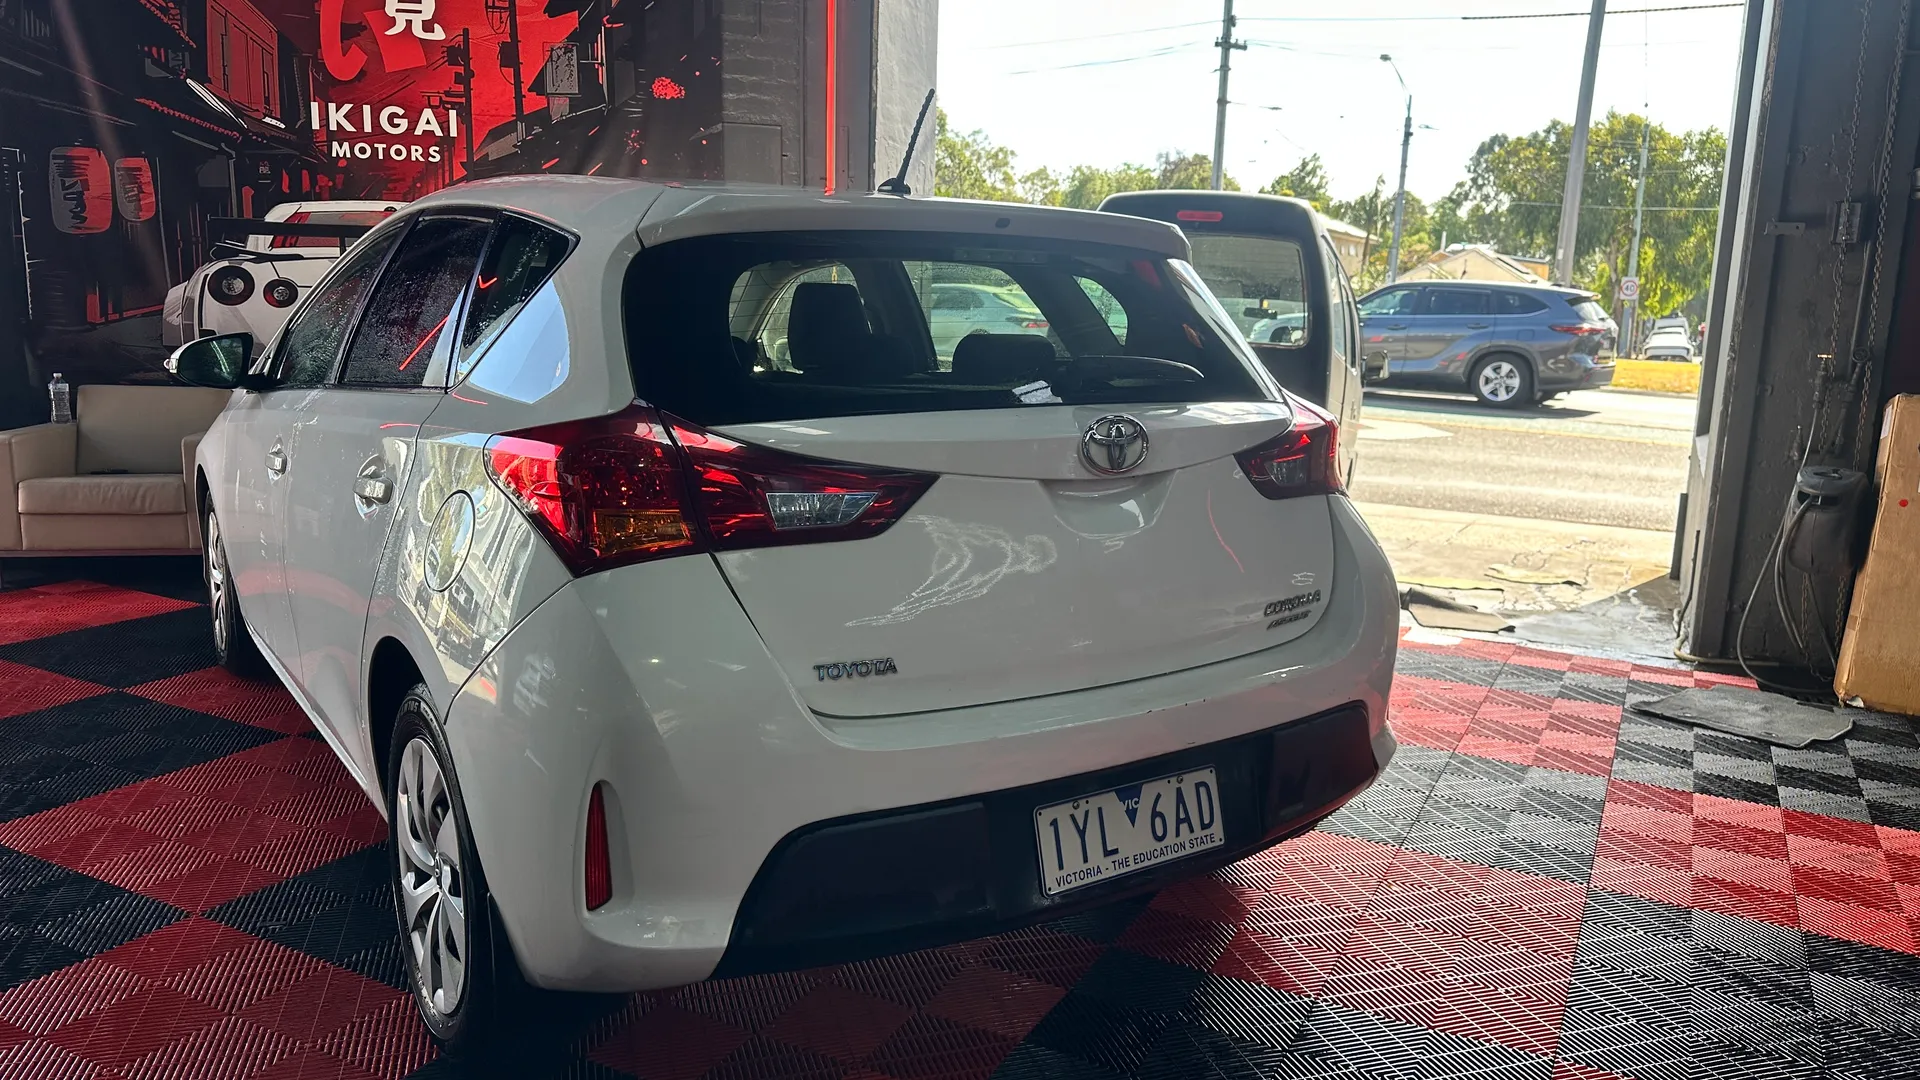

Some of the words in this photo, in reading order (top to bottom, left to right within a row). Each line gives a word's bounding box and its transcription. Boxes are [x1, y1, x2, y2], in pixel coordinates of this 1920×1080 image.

[310, 101, 458, 138] IKIGAI
[331, 141, 441, 162] MOTORS
[1624, 284, 1635, 293] 40
[813, 657, 898, 681] TOYOTA
[1049, 806, 1119, 871] 1YL
[1151, 781, 1215, 843] 6AD
[1055, 865, 1102, 888] VICTORIA
[1111, 856, 1130, 871] THE
[1134, 842, 1187, 865] EDUCATION
[1188, 833, 1216, 853] STATE
